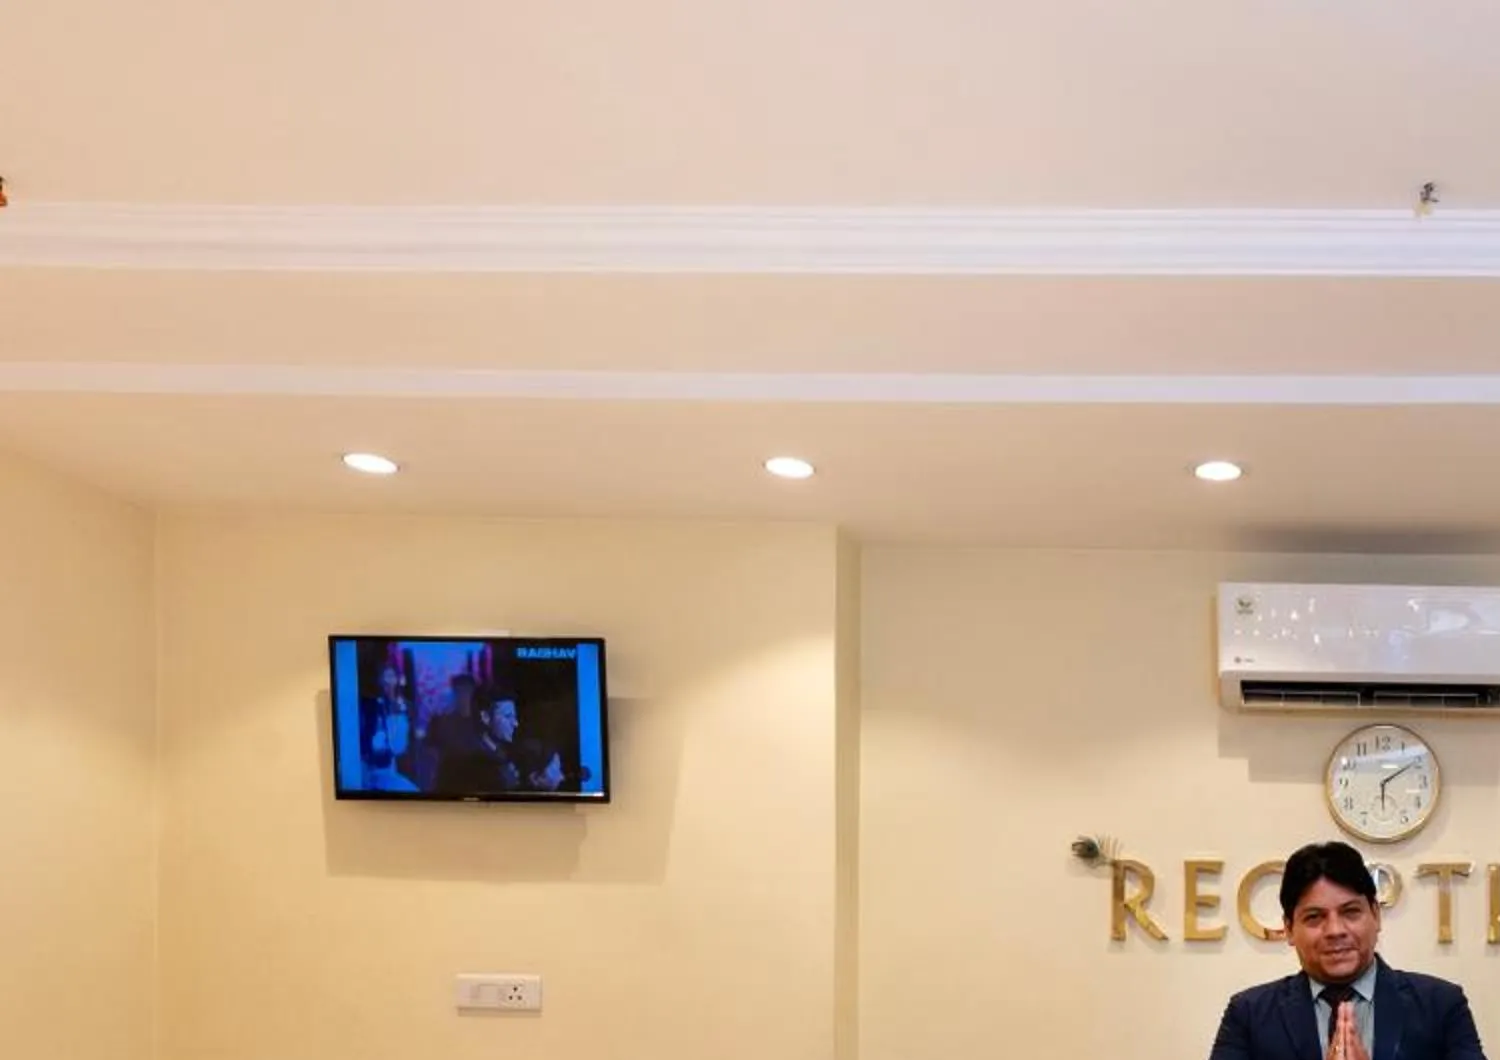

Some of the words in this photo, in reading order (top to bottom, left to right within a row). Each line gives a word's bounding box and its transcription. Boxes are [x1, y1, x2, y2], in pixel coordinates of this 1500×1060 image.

[1356, 742, 1368, 757] 11
[1375, 735, 1392, 752] 12
[1339, 778, 1349, 789] 9
[1344, 796, 1354, 811] 8
[1359, 811, 1369, 826] 7
[1400, 809, 1410, 824] 5
